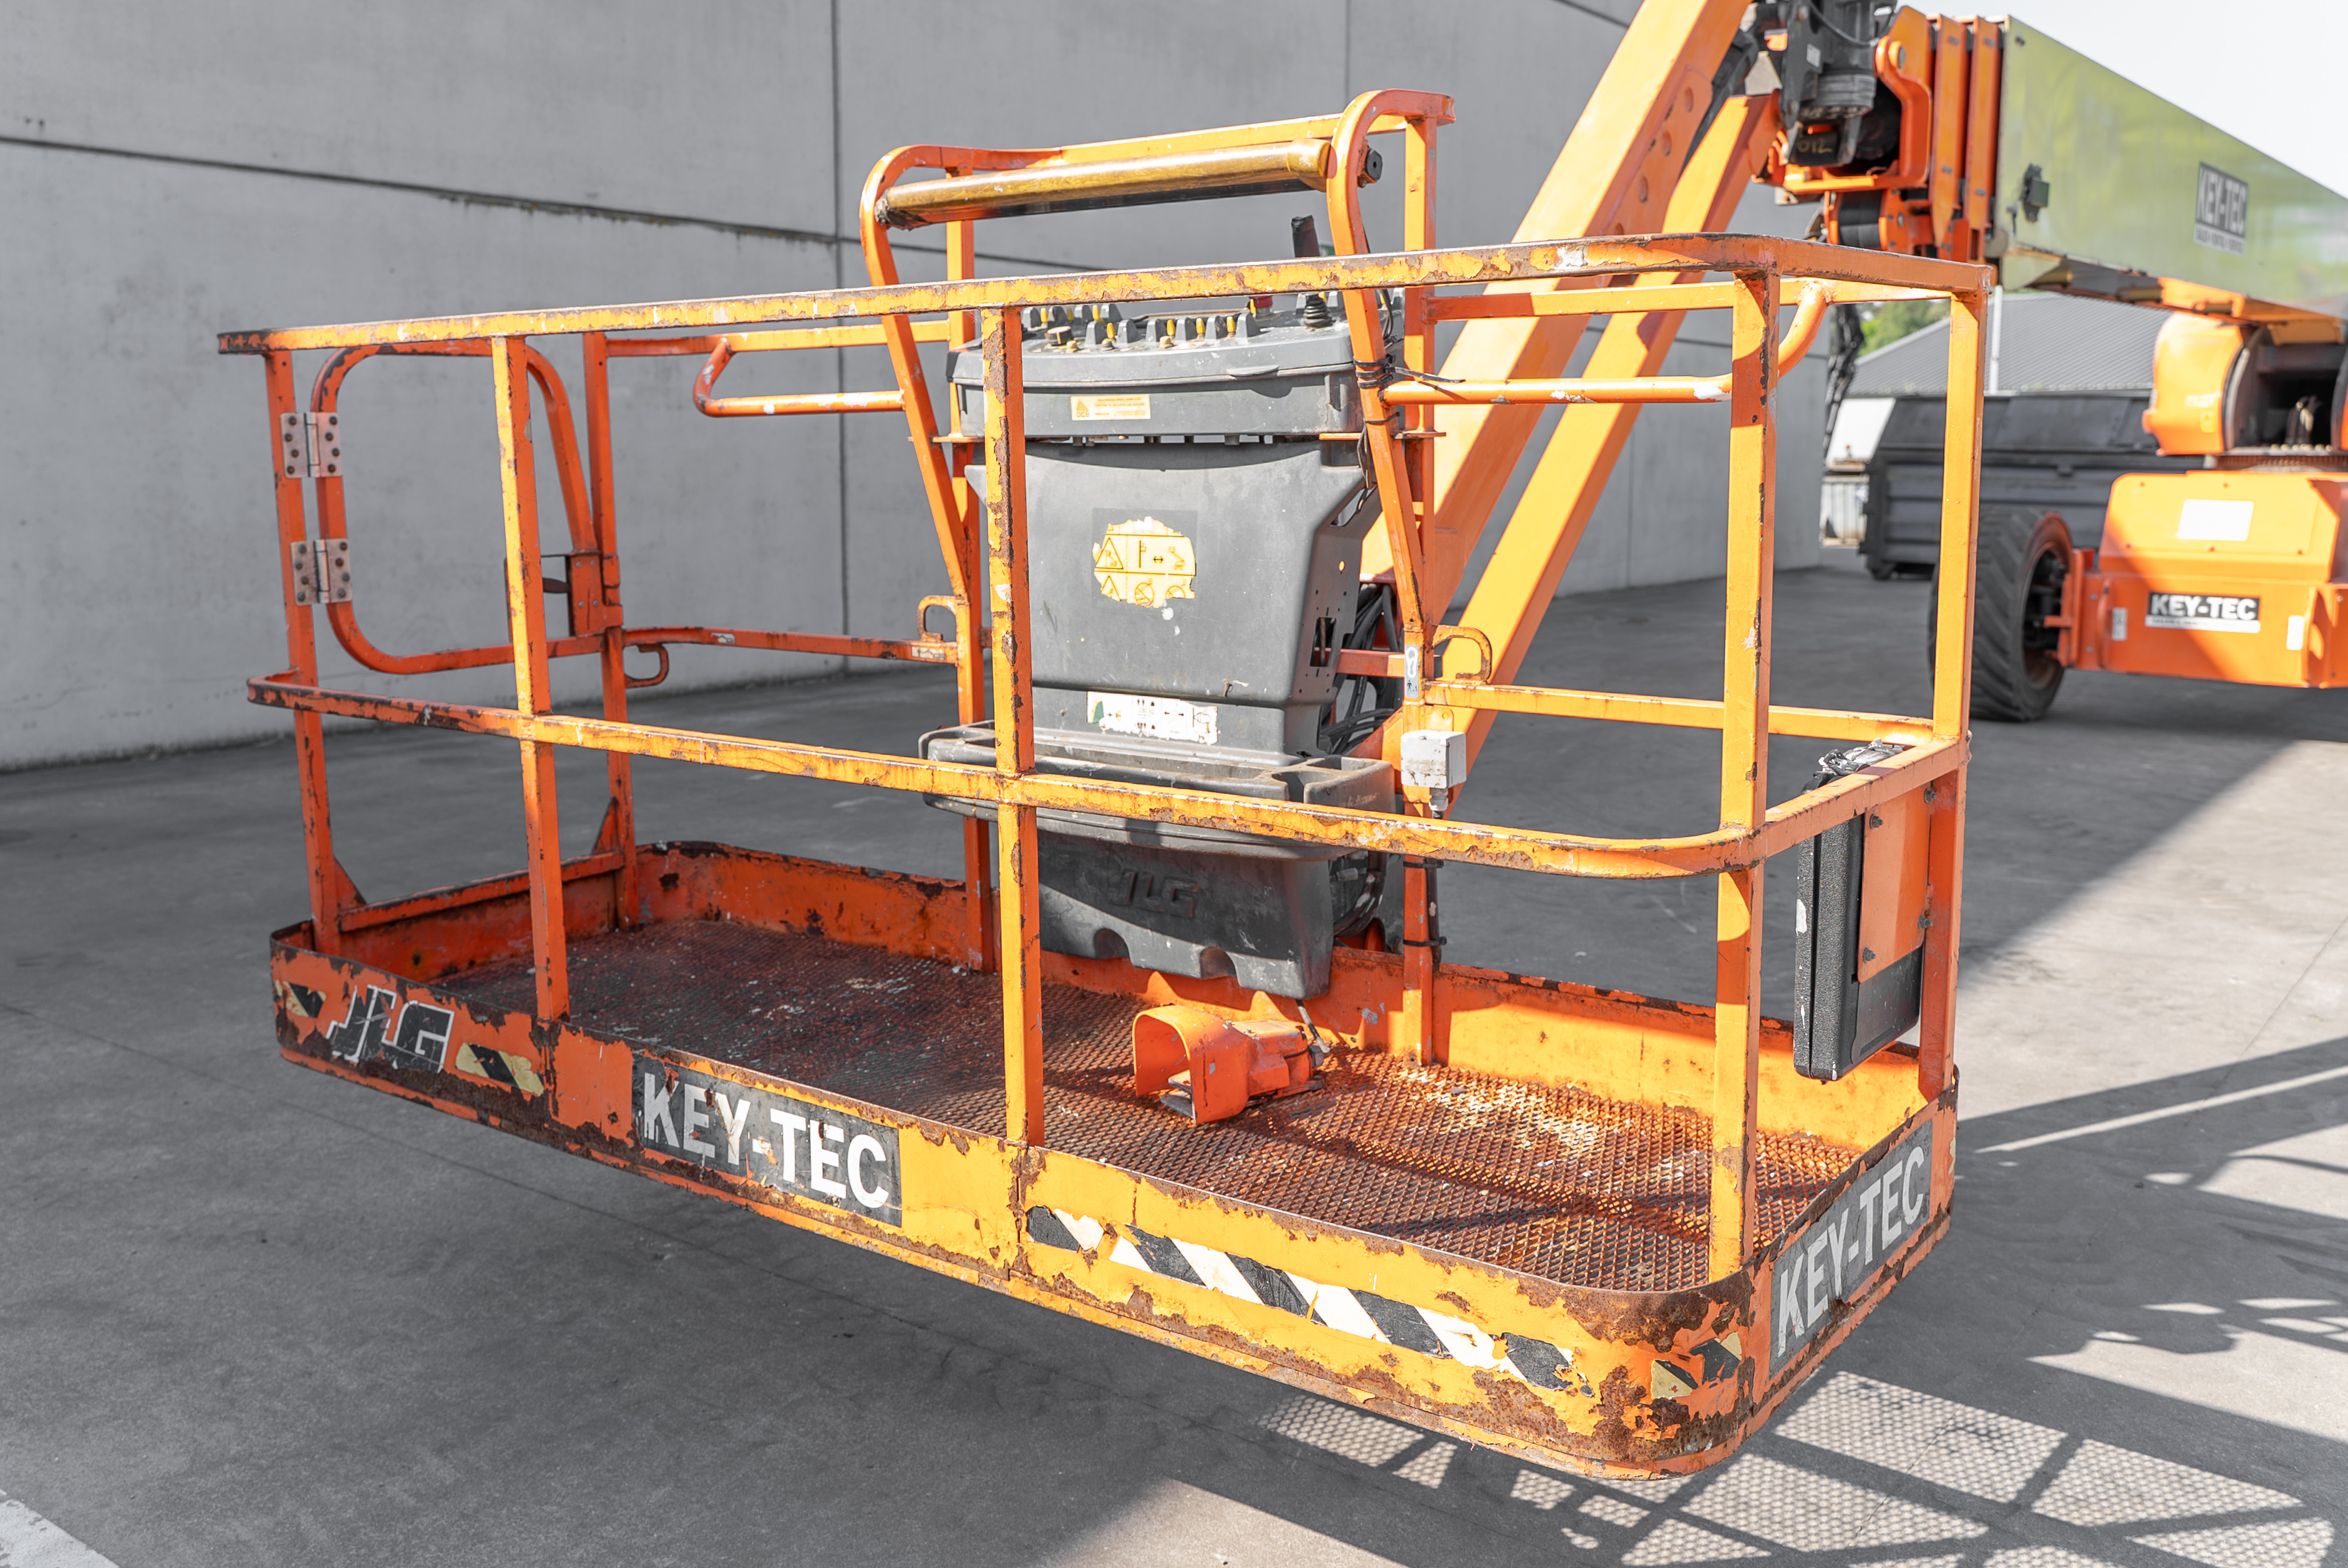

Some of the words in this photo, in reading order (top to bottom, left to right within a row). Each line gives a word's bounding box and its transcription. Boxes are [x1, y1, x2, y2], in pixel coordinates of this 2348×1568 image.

[2196, 166, 2246, 235] KEY-TEC
[2151, 594, 2257, 621] KEY-TEC
[325, 984, 455, 1074] JLG
[644, 1072, 890, 1209] KEY-TEC
[1777, 1146, 1924, 1358] KEY-TEC
